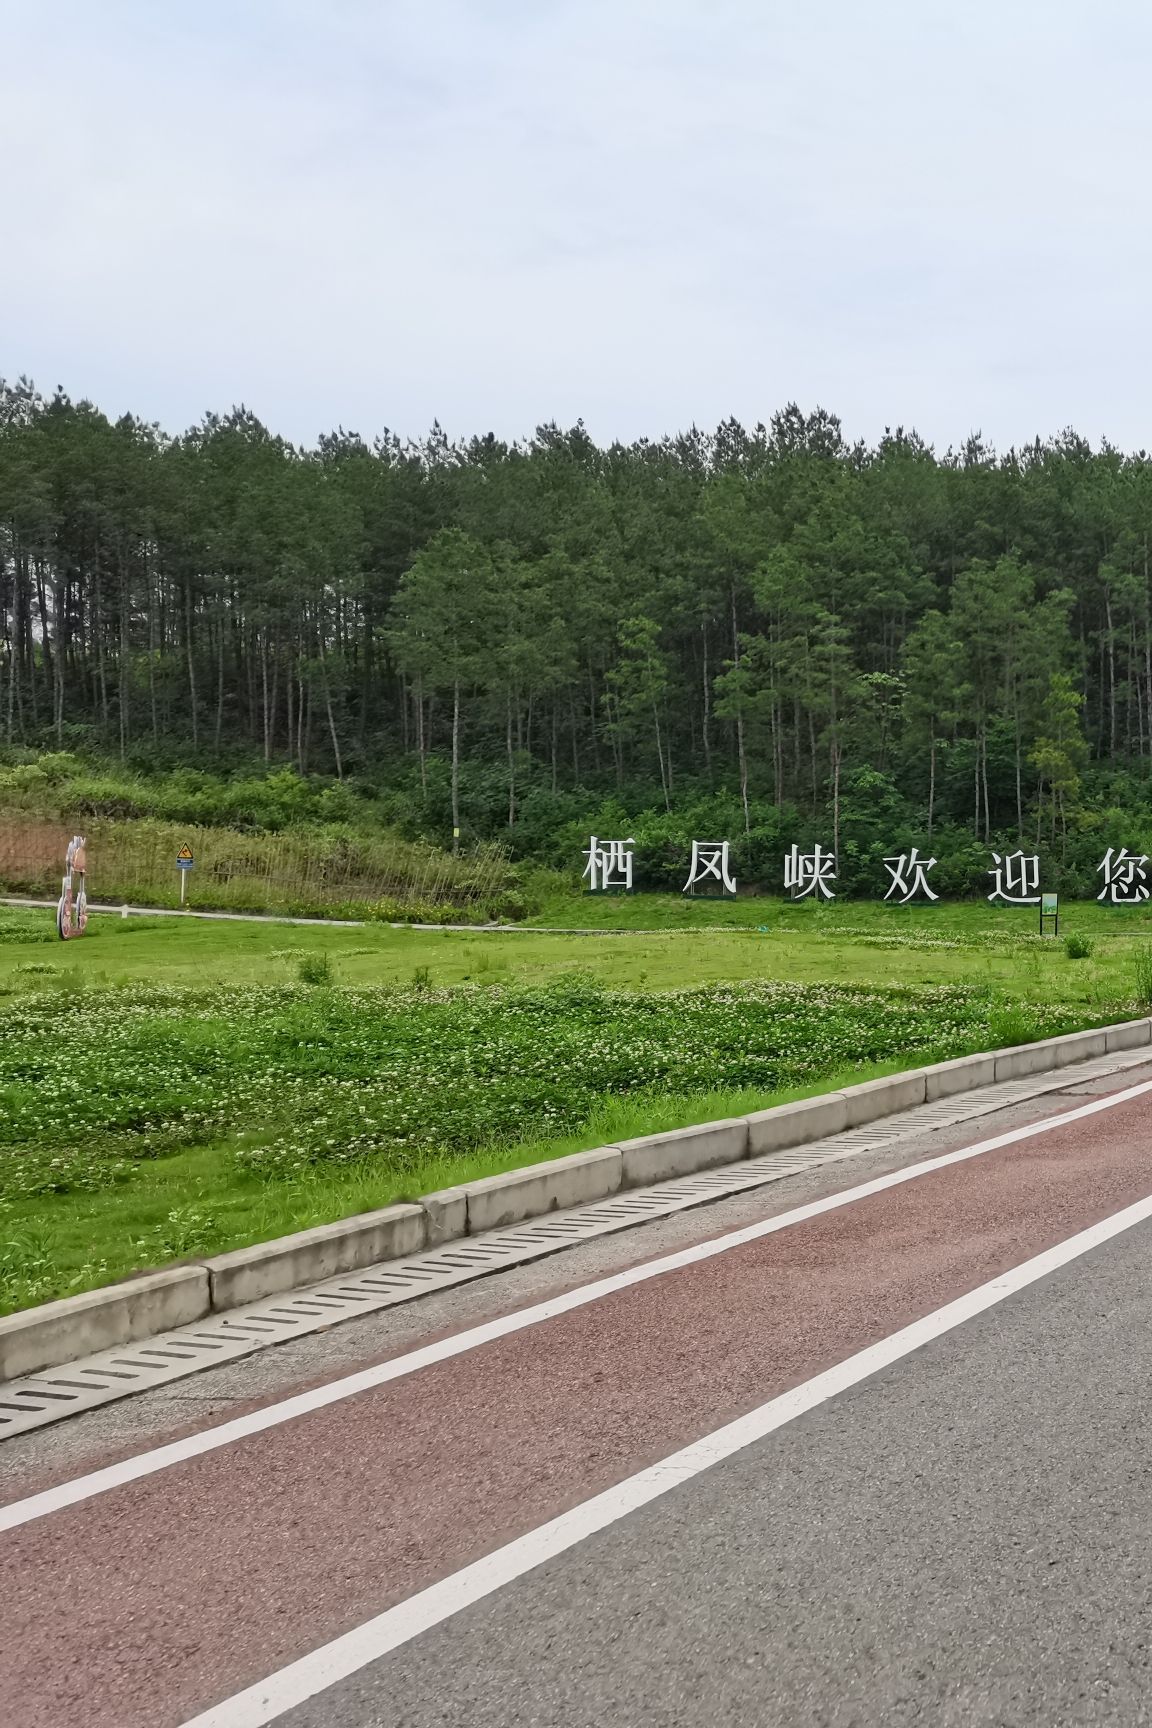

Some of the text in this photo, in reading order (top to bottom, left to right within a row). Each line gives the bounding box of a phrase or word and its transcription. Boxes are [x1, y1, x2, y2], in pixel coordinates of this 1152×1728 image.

[581, 835, 1150, 904] 栖凤峡欢迎您
